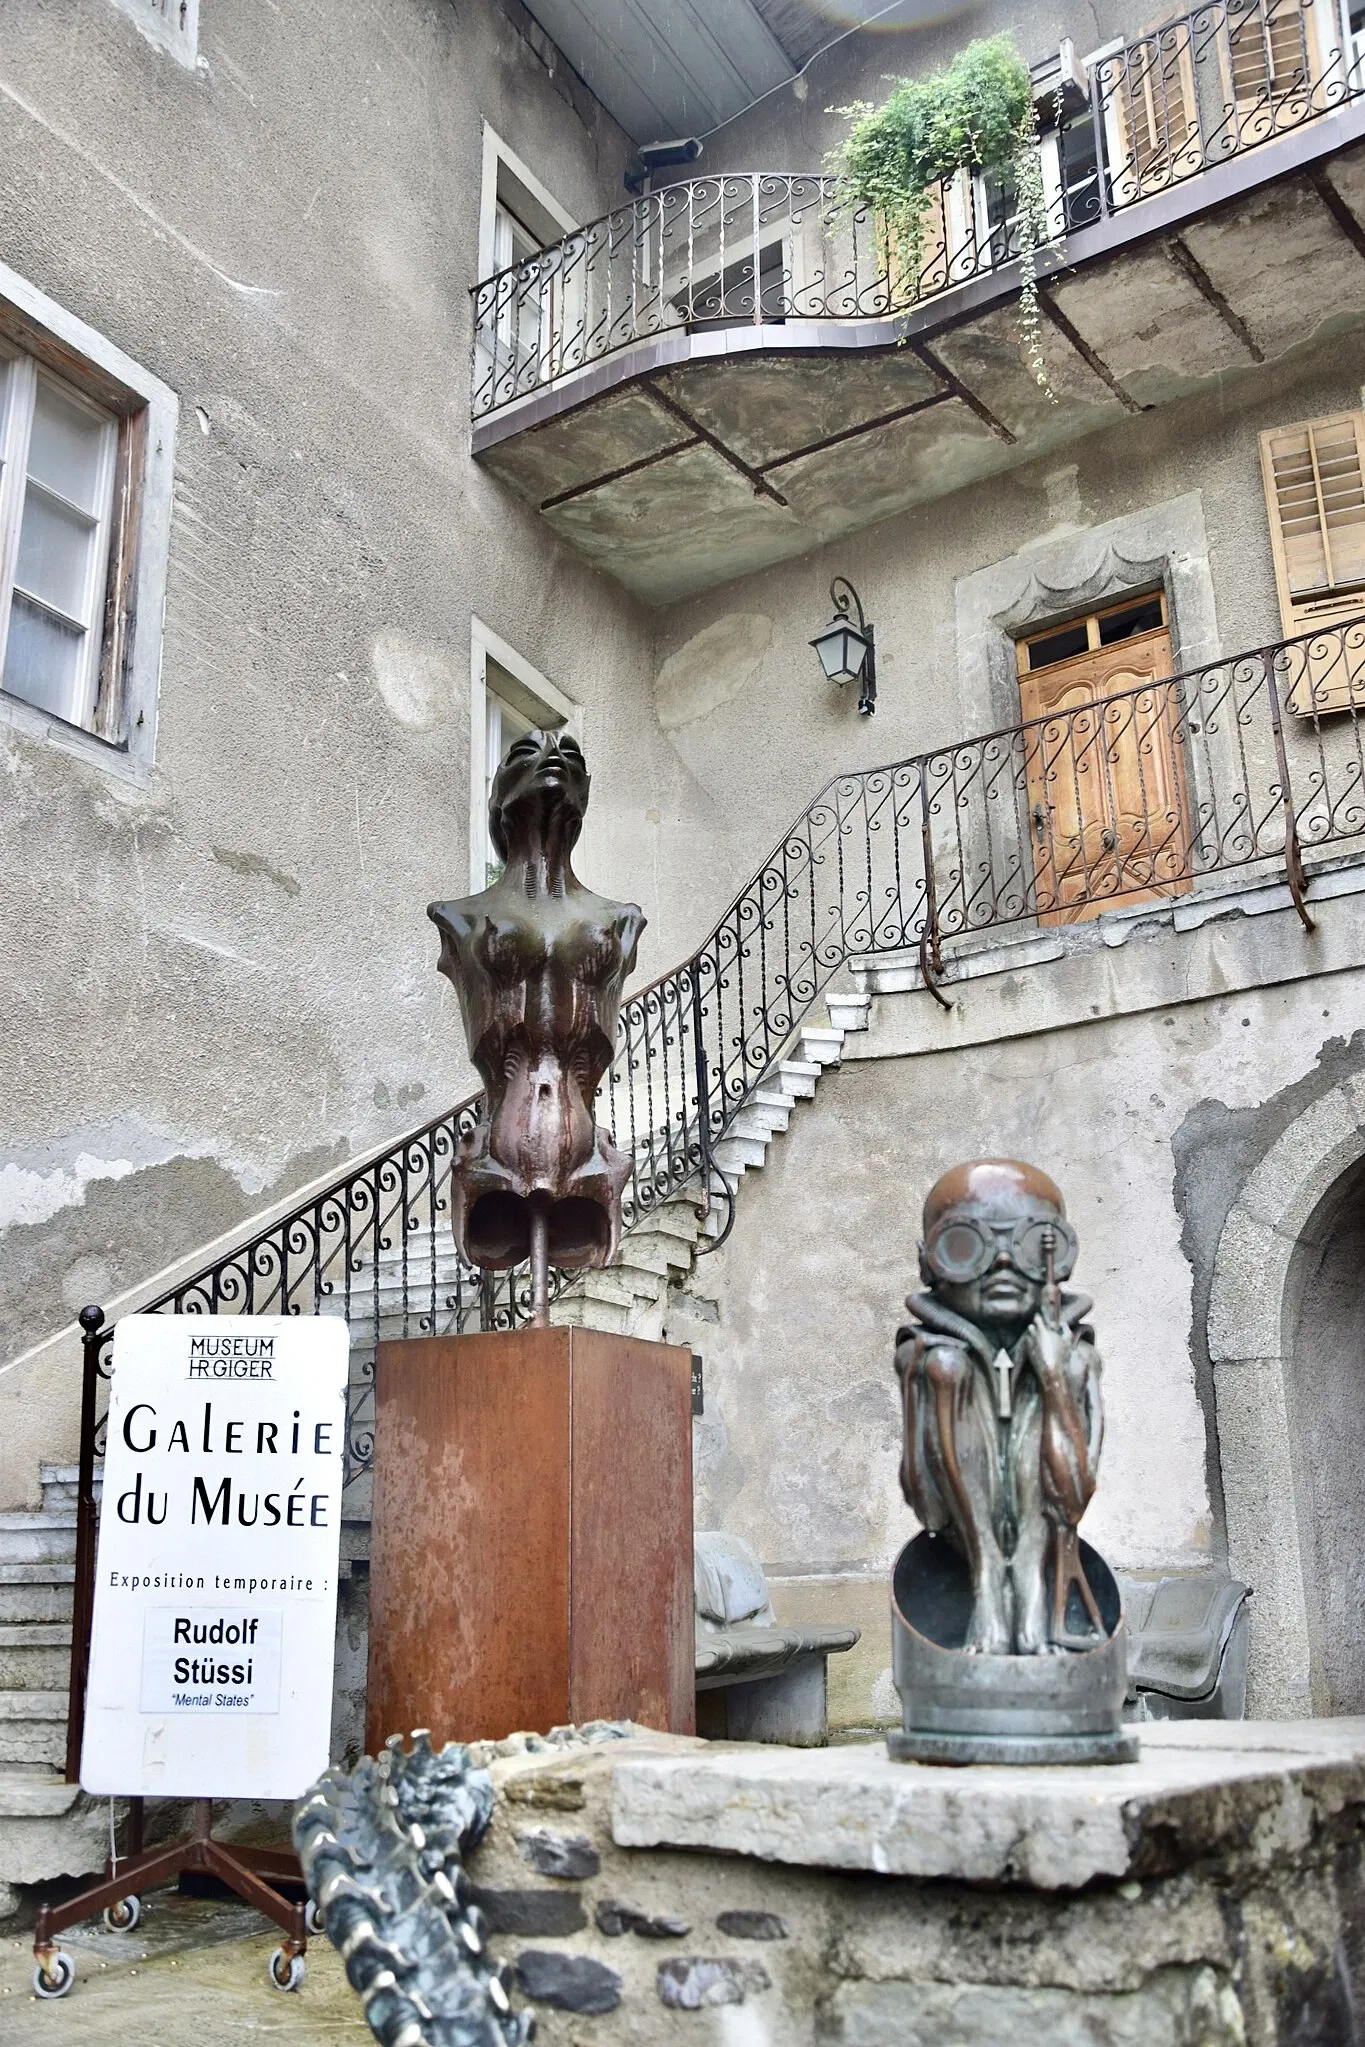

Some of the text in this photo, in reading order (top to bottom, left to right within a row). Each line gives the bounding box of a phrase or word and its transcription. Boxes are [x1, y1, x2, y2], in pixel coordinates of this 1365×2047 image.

[191, 1338, 274, 1356] MUSEUM
[116, 1472, 168, 1525] du
[110, 1571, 205, 1592] Exposition
[215, 1575, 313, 1594] temporaire
[173, 1617, 259, 1645] Rudolf
[173, 1657, 253, 1685] Stüssi
